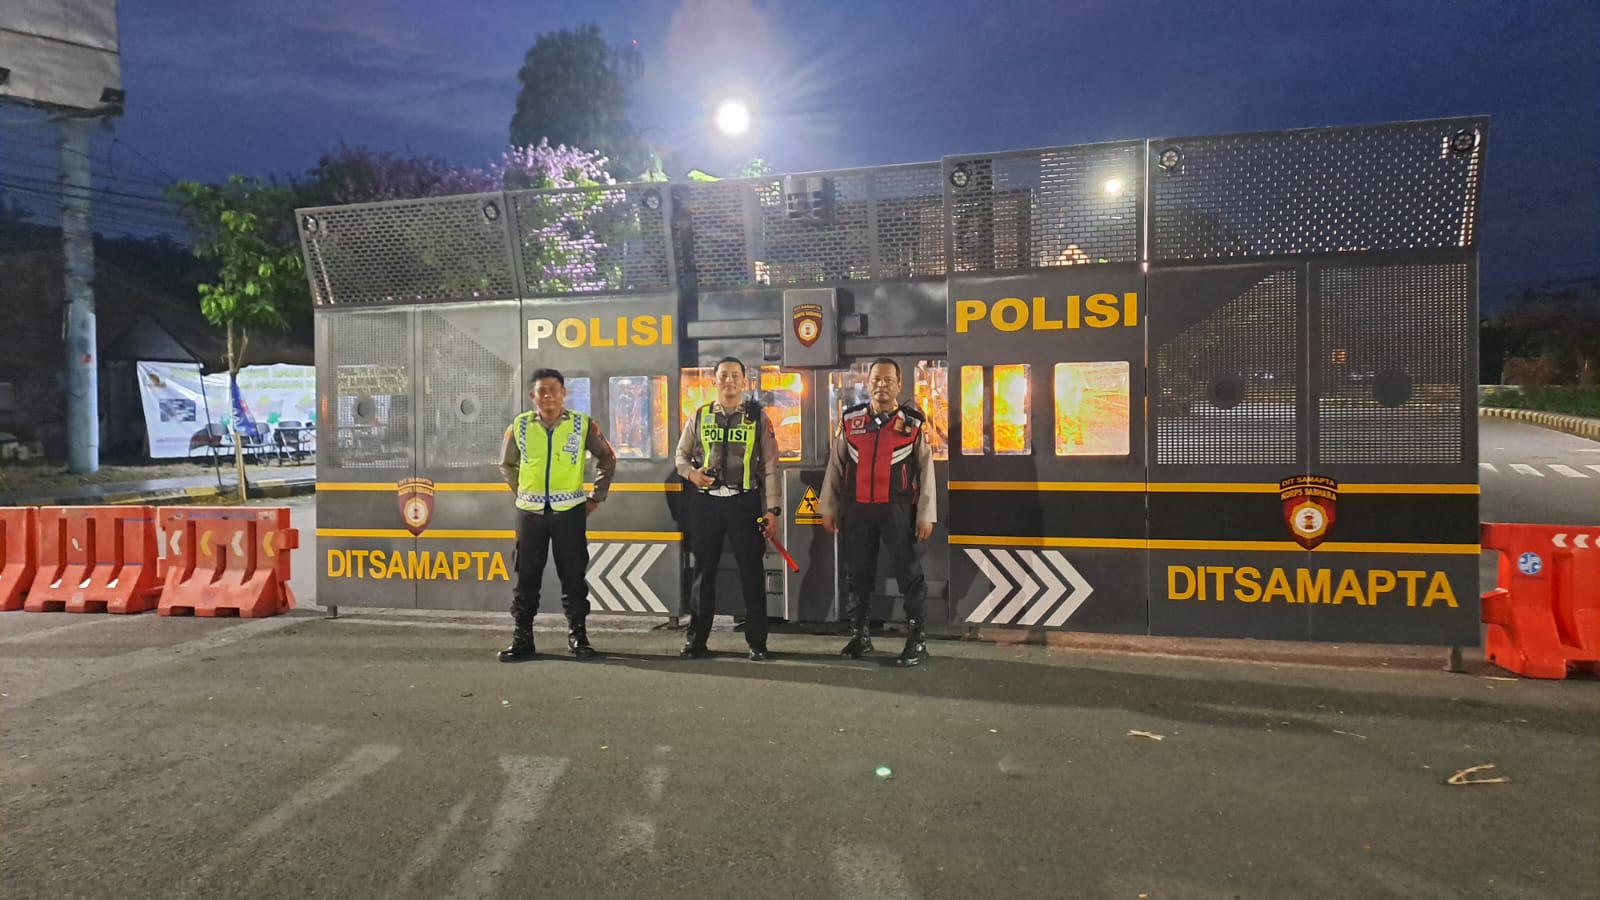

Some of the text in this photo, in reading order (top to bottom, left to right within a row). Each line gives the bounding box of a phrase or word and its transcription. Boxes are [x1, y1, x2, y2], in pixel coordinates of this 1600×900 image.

[954, 291, 1139, 334] POLISI
[527, 315, 673, 349] POLISI
[704, 429, 748, 441] POLISI
[1281, 476, 1335, 487] DIT SAMAPTA
[326, 549, 510, 582] DITSAMAPTA
[1167, 565, 1459, 609] DITSAMAPTA
